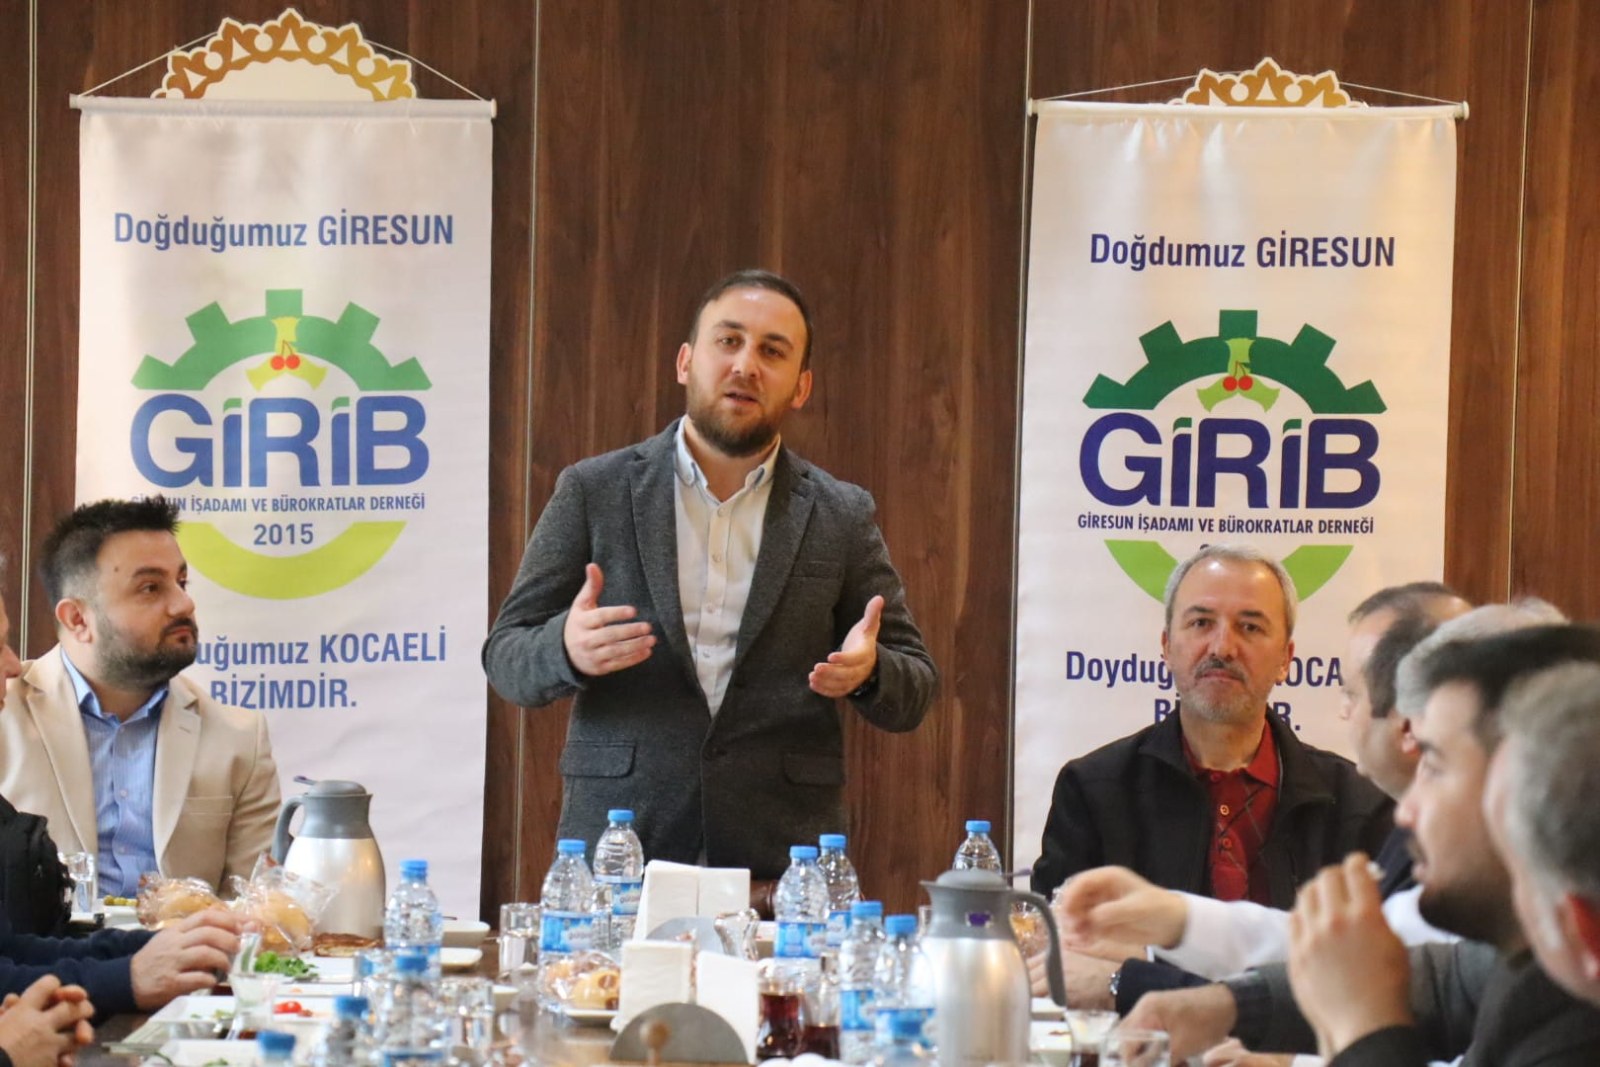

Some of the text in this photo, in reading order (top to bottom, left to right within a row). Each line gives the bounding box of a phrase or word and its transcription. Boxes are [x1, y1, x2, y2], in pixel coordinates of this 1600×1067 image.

[115, 208, 453, 254] Doğduğumuz GİRESUN
[1090, 229, 1395, 272] Doğdumuz GİRESUN
[251, 497, 268, 512] VE
[271, 494, 366, 513] BÜROKRATLAR
[370, 492, 426, 511] DERNEĞİ
[253, 522, 314, 546] 2015
[1077, 511, 1374, 535] GİRESUN İŞADAMI VE BÜROKRATLAR DERNEĞİ
[196, 625, 446, 671] uğumuz KOCAELİ
